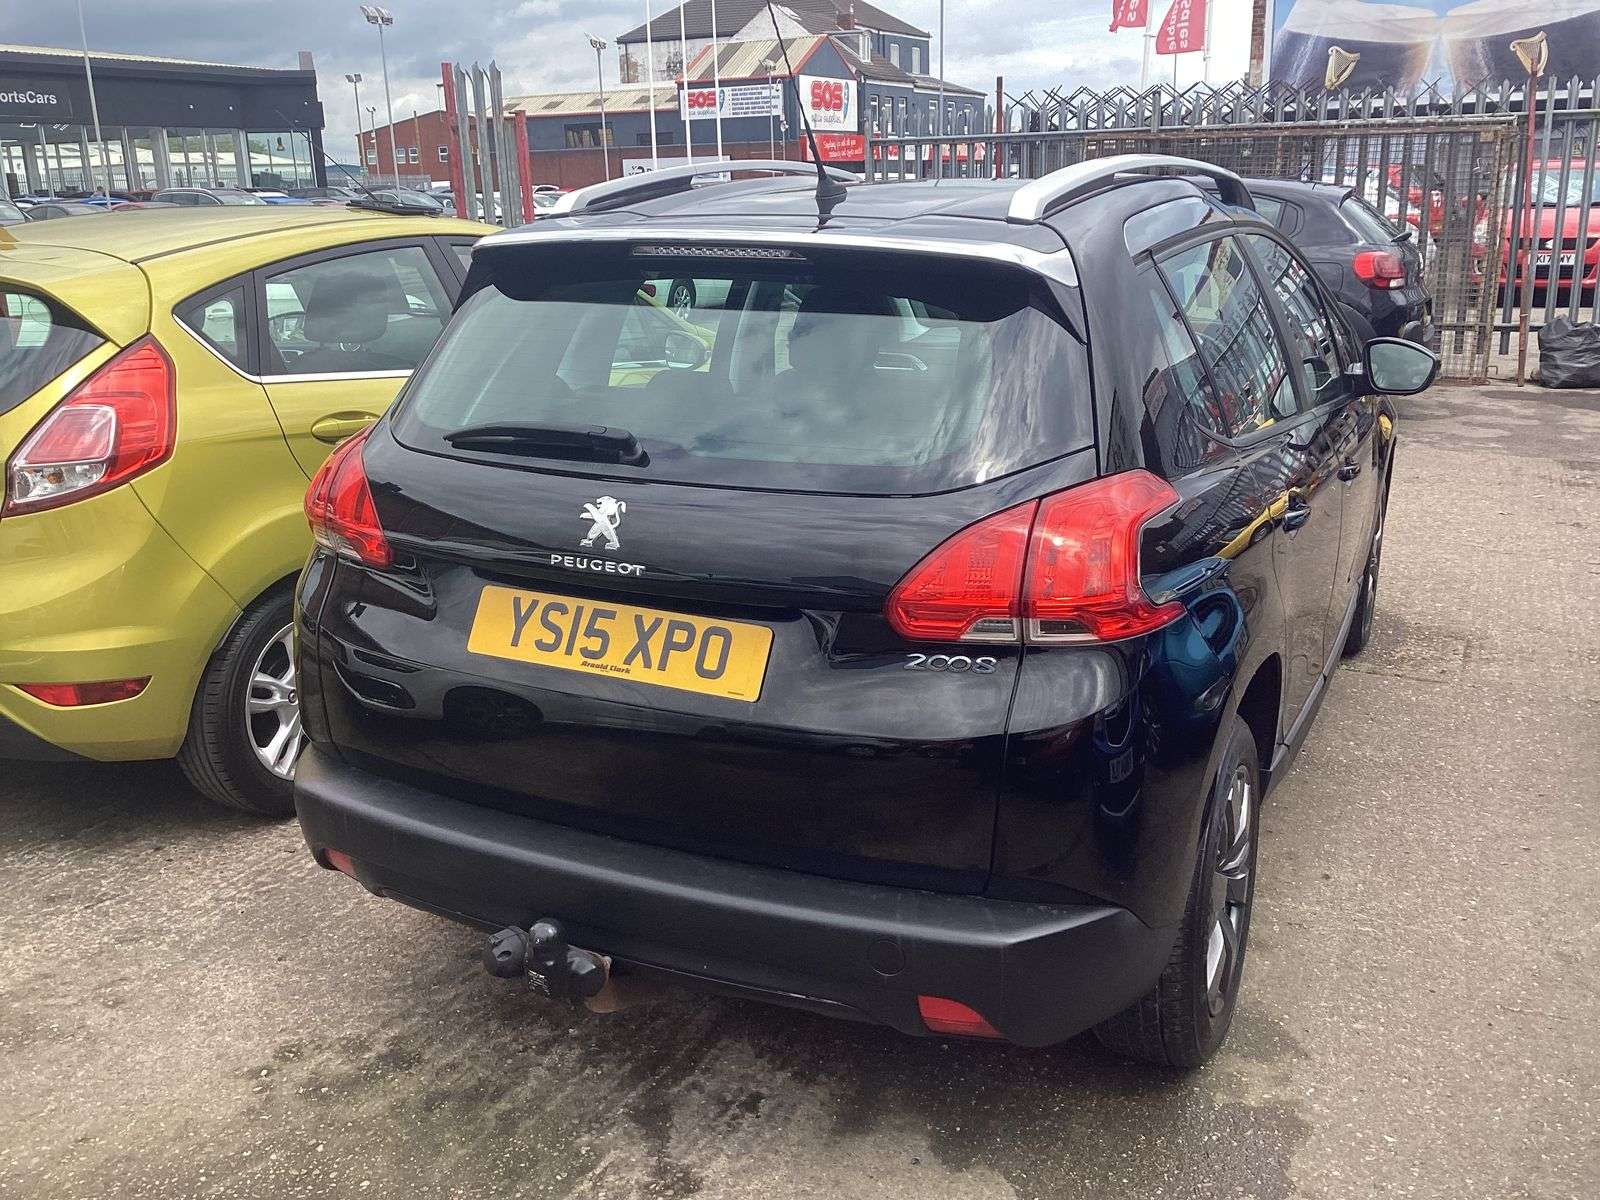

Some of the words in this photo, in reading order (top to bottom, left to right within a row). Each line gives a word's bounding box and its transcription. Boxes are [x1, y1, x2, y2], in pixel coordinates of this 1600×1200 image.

[686, 90, 717, 109] SOS
[811, 80, 843, 111] SOS
[550, 554, 646, 576] PEUGEOT
[510, 596, 617, 660] YS15
[622, 613, 733, 680] XPO
[581, 660, 608, 670] Arnold
[609, 664, 631, 674] Clark
[903, 653, 997, 674] 2008
